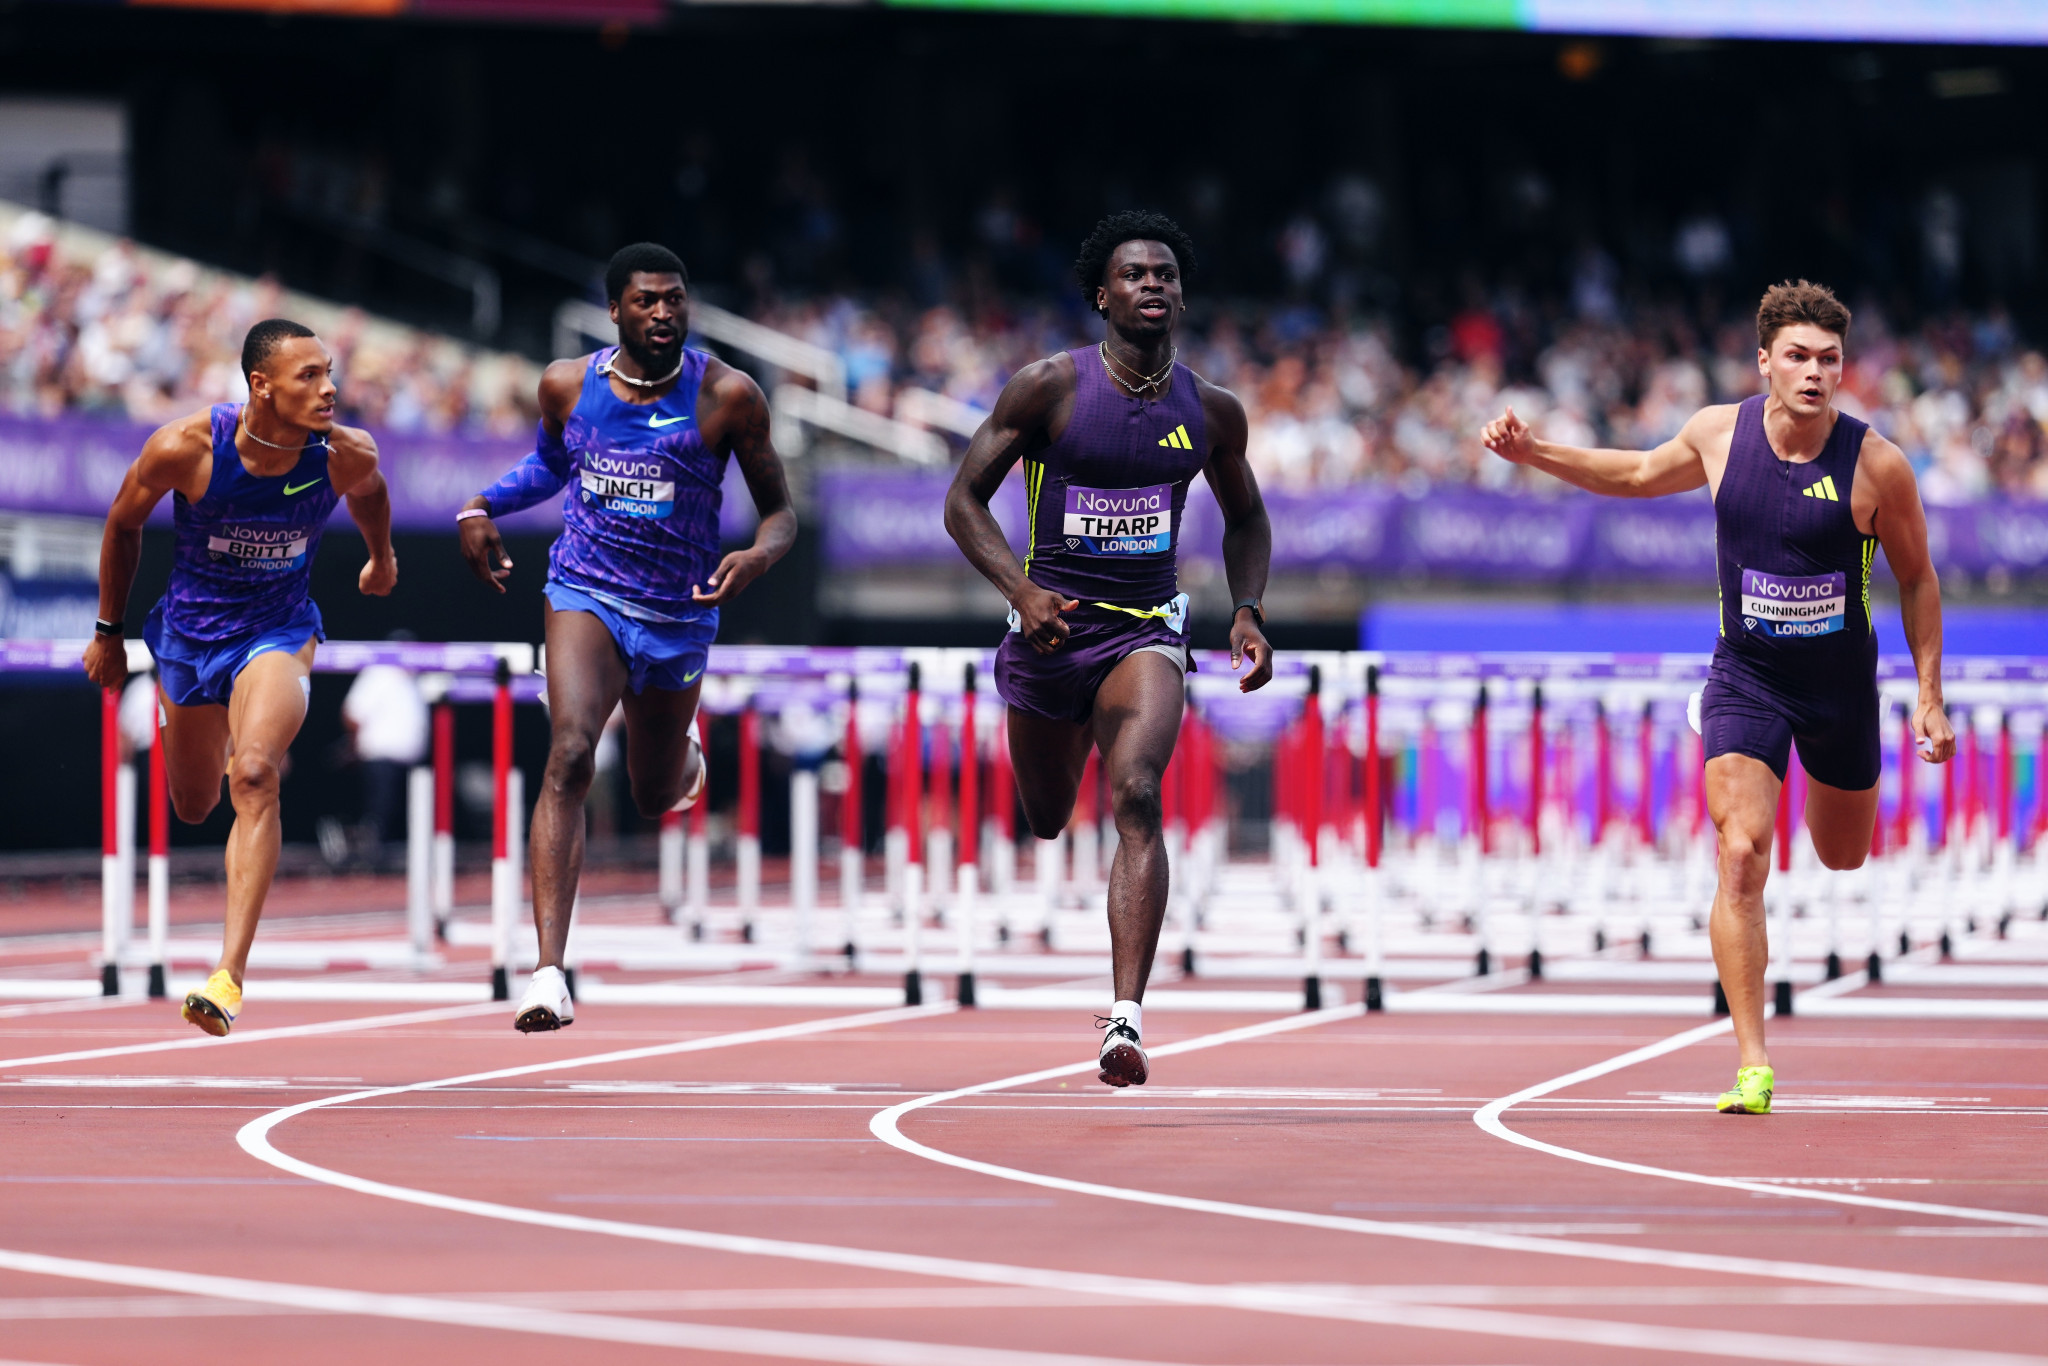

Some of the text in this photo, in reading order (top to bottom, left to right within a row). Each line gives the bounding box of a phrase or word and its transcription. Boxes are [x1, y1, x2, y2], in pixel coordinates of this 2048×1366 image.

[584, 450, 661, 478] Novuna
[593, 475, 654, 499] TINCH
[605, 499, 658, 515] LONDON
[1077, 491, 1160, 512] Novuna
[222, 524, 302, 542] Novuna
[1080, 516, 1159, 536] THARP
[228, 541, 292, 558] BRITT
[1101, 539, 1158, 552] LONDON
[240, 560, 294, 570] LONDON
[1751, 575, 1833, 598] Novuna
[1169, 601, 1180, 616] 4
[1751, 602, 1836, 617] CUNNINGHAM
[1775, 620, 1830, 635] LONDON
